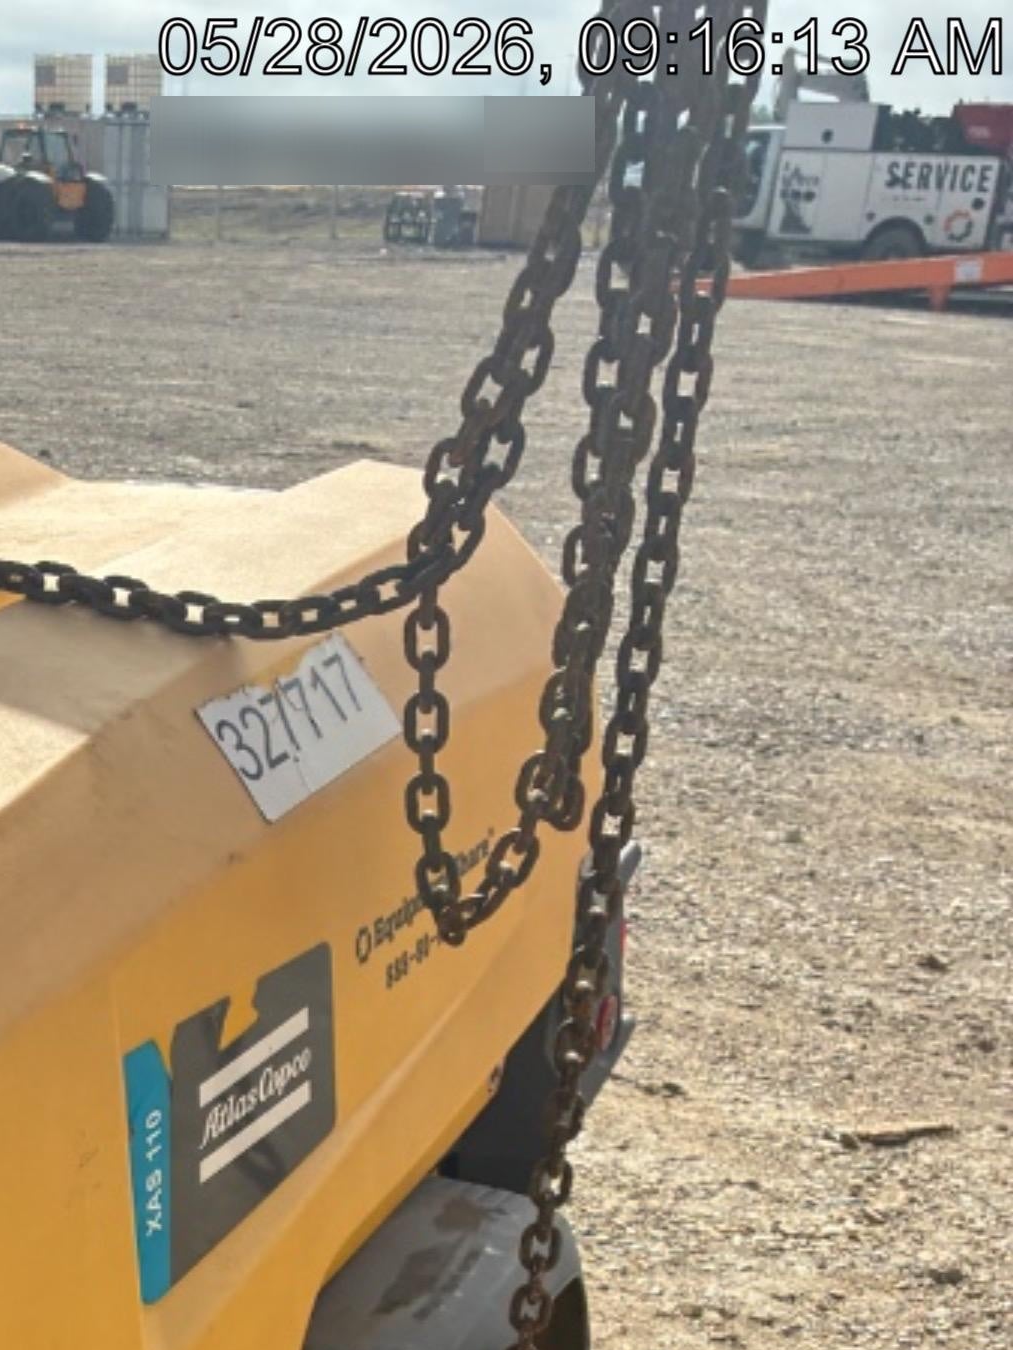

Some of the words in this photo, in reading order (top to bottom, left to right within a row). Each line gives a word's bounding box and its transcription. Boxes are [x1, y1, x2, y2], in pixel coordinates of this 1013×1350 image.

[885, 160, 994, 193] SERVICE
[215, 653, 363, 781] 327717
[144, 1108, 163, 1163] 110
[144, 1168, 163, 1238] XAS
